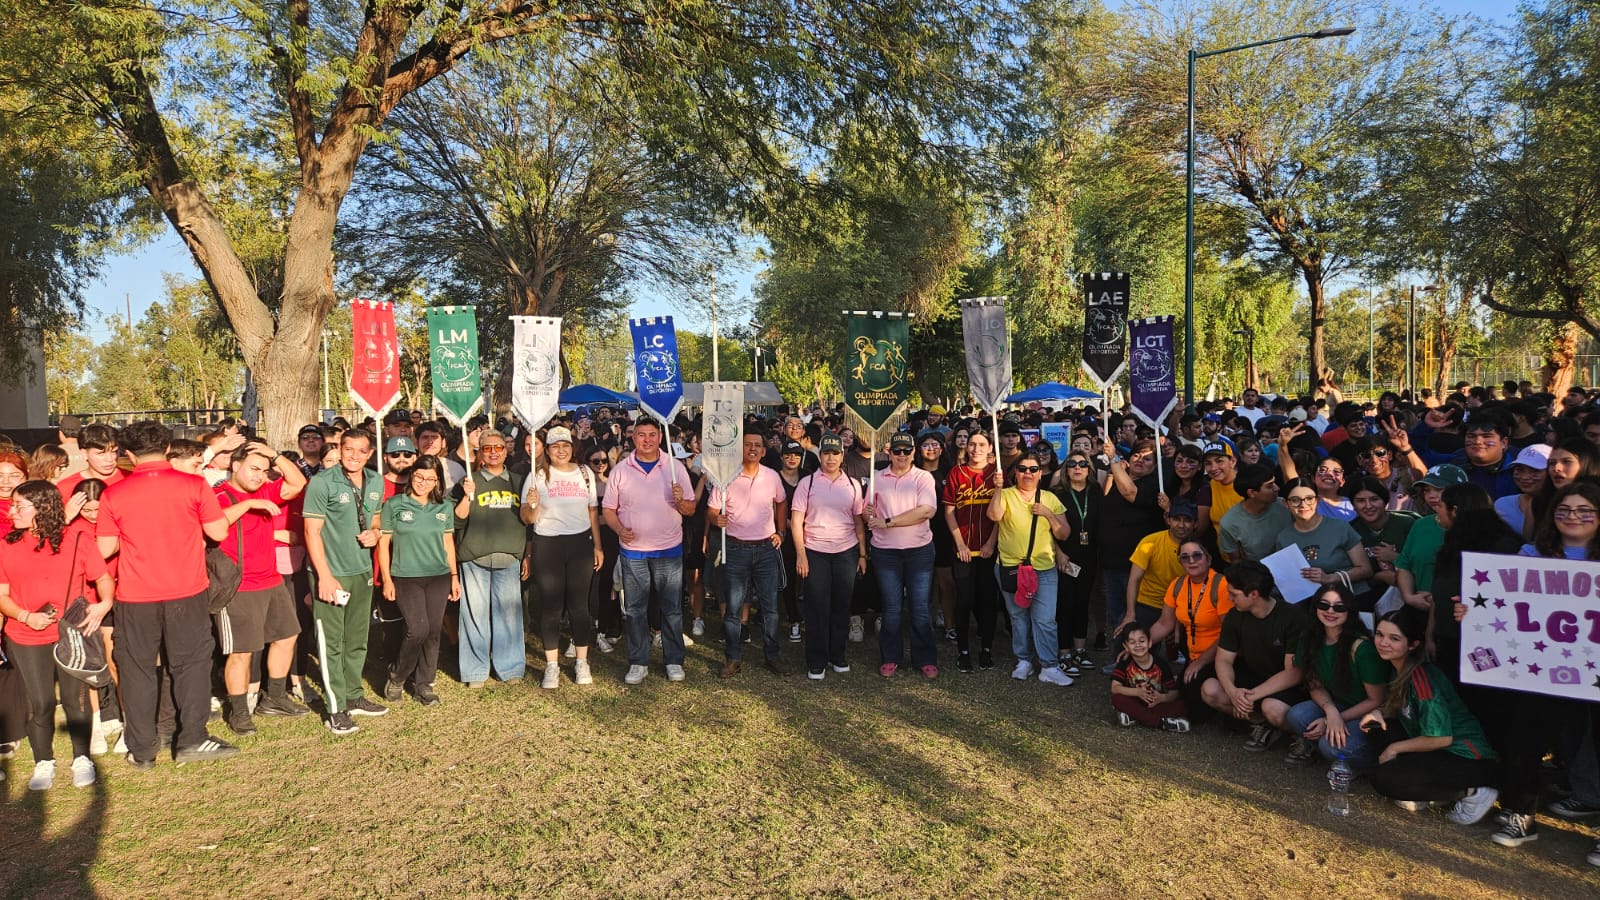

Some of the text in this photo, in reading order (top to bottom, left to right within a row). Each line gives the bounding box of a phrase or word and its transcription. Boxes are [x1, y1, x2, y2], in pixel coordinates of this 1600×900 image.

[1088, 291, 1124, 306] LAE
[438, 329, 469, 345] LM
[643, 334, 665, 349] LC
[1136, 335, 1167, 349] LGT
[869, 363, 887, 371] FCA
[440, 381, 475, 389] OLIMPIADA
[646, 382, 677, 390] OLIMPIADA
[1137, 381, 1171, 389] OLIMPIADA
[854, 392, 898, 400] OLIMPIADA
[712, 400, 733, 412] TC
